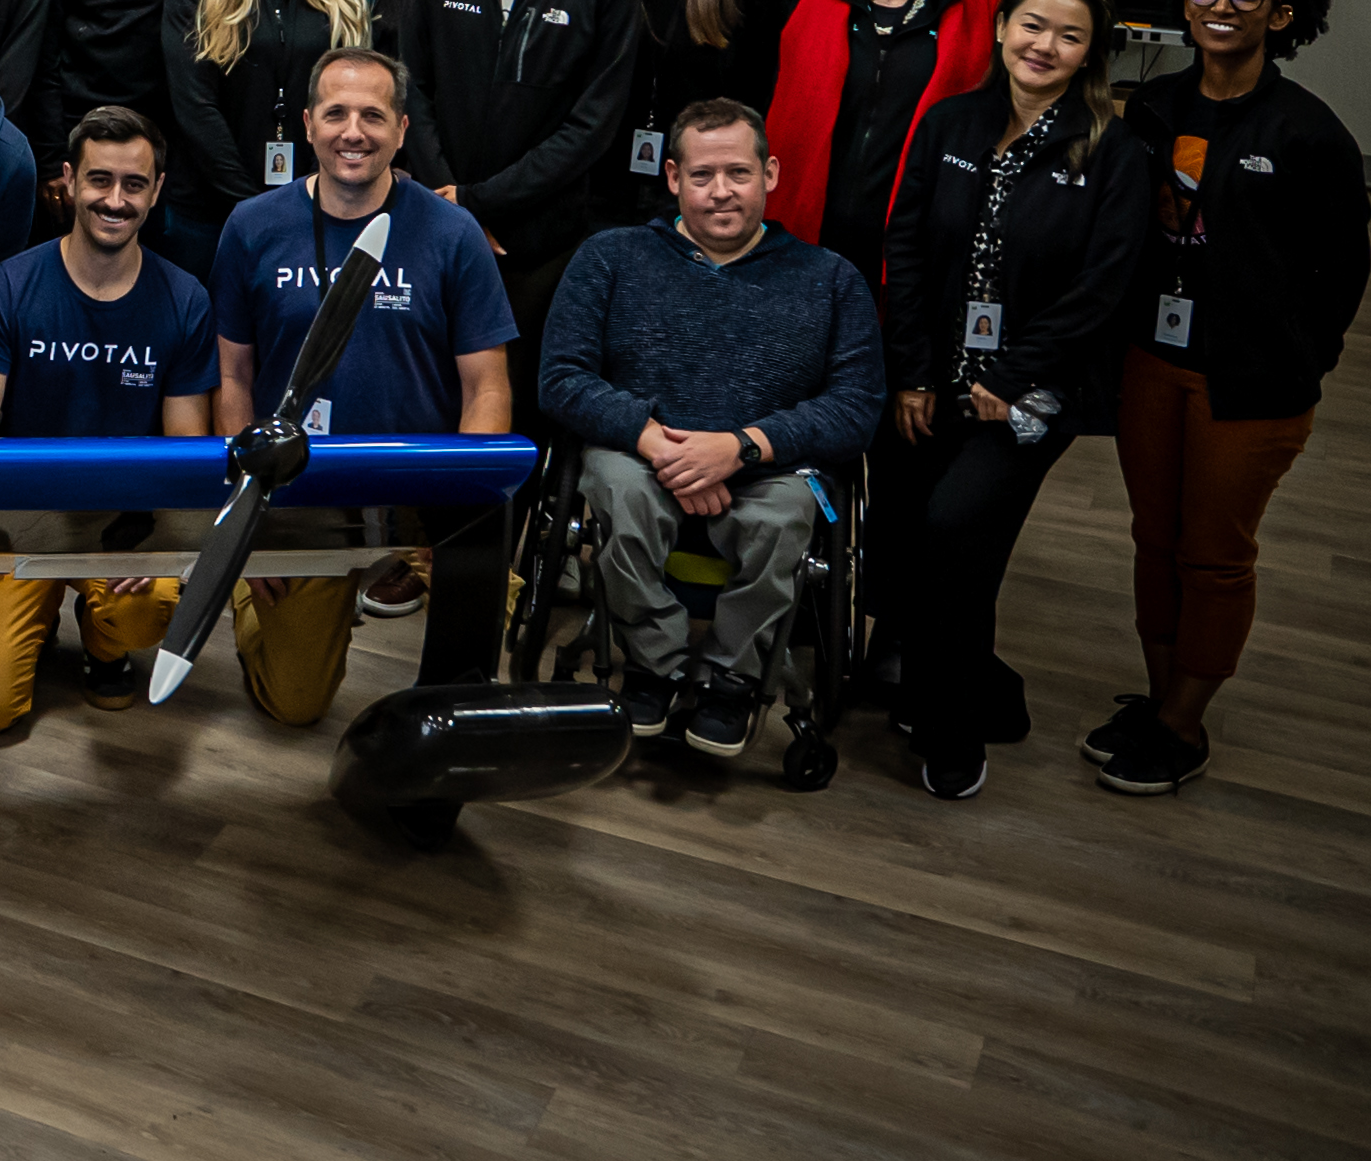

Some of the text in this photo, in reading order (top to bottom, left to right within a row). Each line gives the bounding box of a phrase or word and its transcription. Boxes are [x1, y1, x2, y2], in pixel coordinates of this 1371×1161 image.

[443, 0, 482, 14] PIVOTAL
[942, 153, 978, 174] PIVOTA
[277, 267, 412, 288] PIVAL
[29, 340, 157, 365] PIVOTAL
